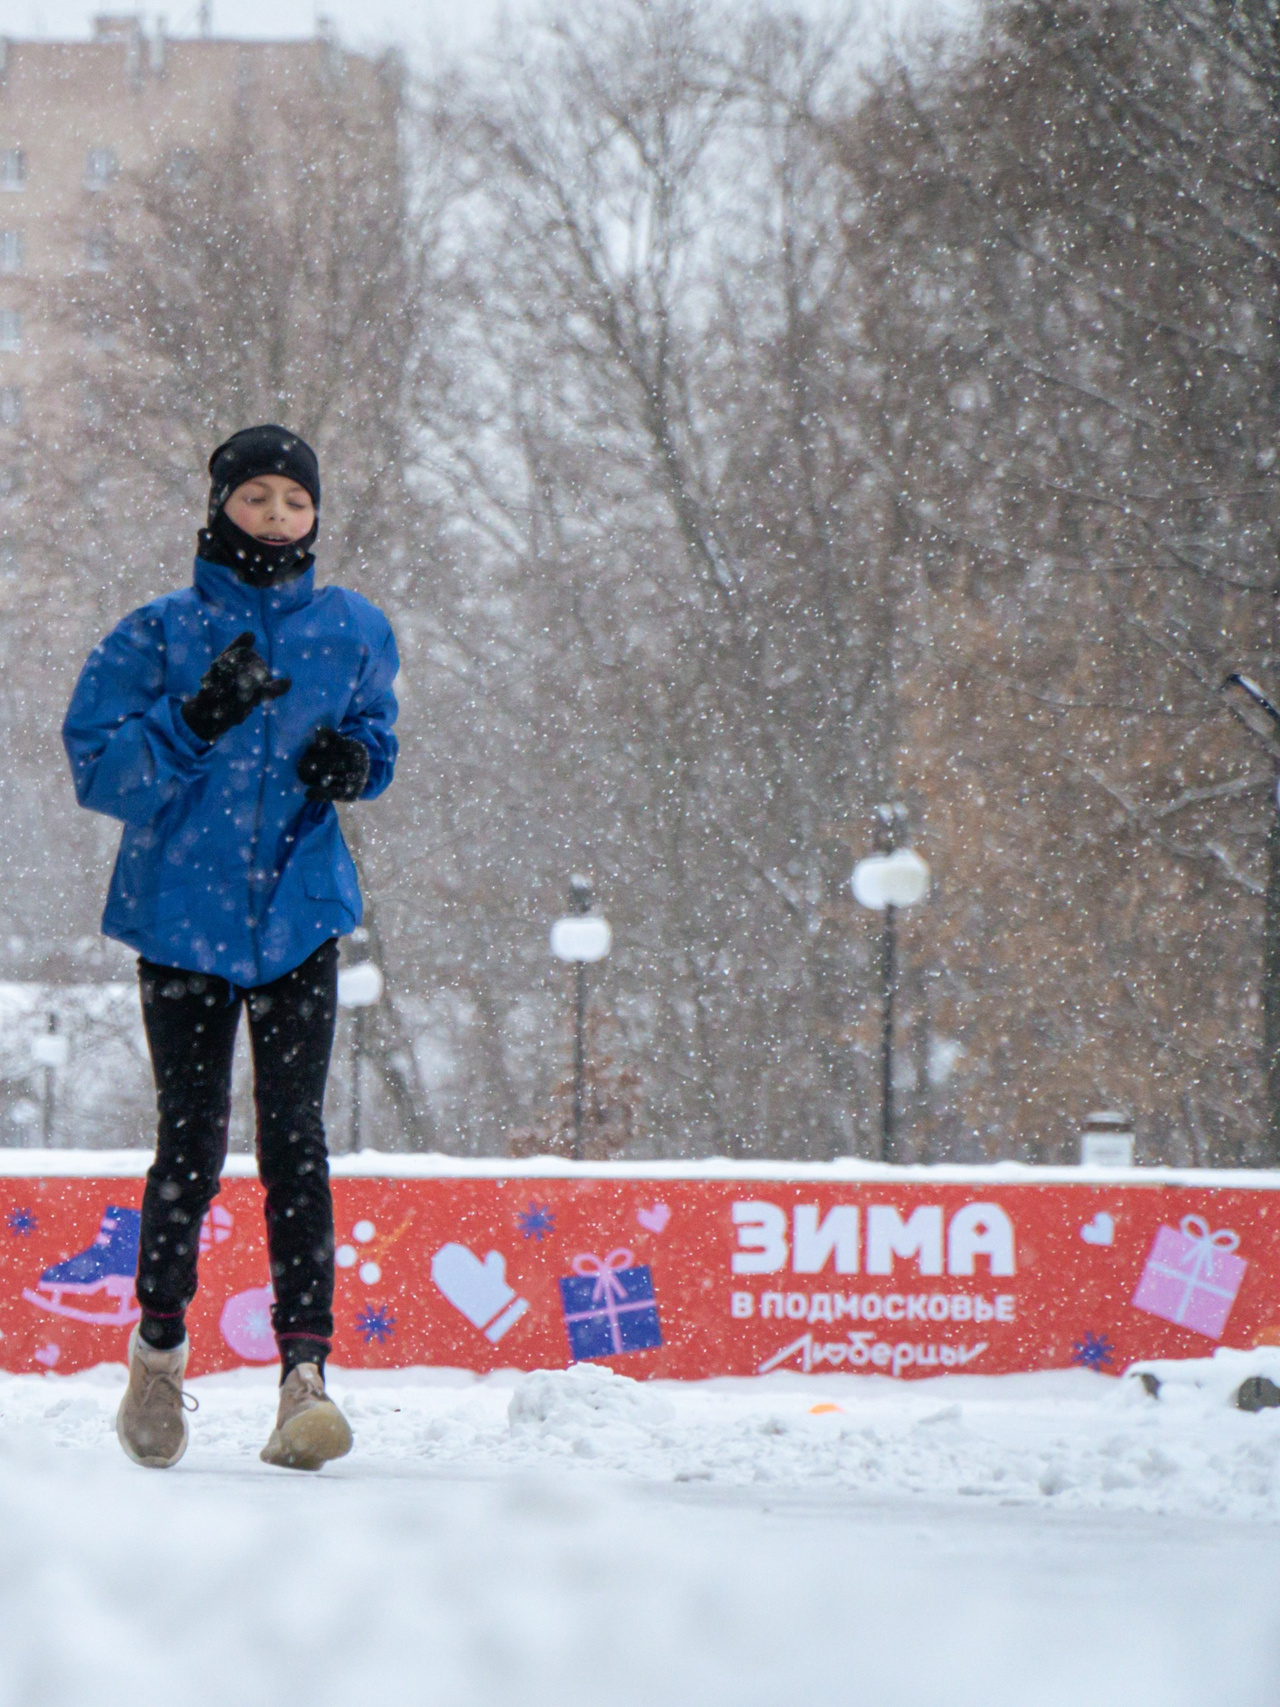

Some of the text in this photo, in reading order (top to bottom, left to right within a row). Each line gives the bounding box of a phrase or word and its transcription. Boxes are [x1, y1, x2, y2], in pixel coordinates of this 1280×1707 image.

[731, 1201, 1016, 1277] ЗИМА
[731, 1292, 1016, 1323] В ПОДМОСКОВЬЕ
[757, 1331, 988, 1377] Люберцы
